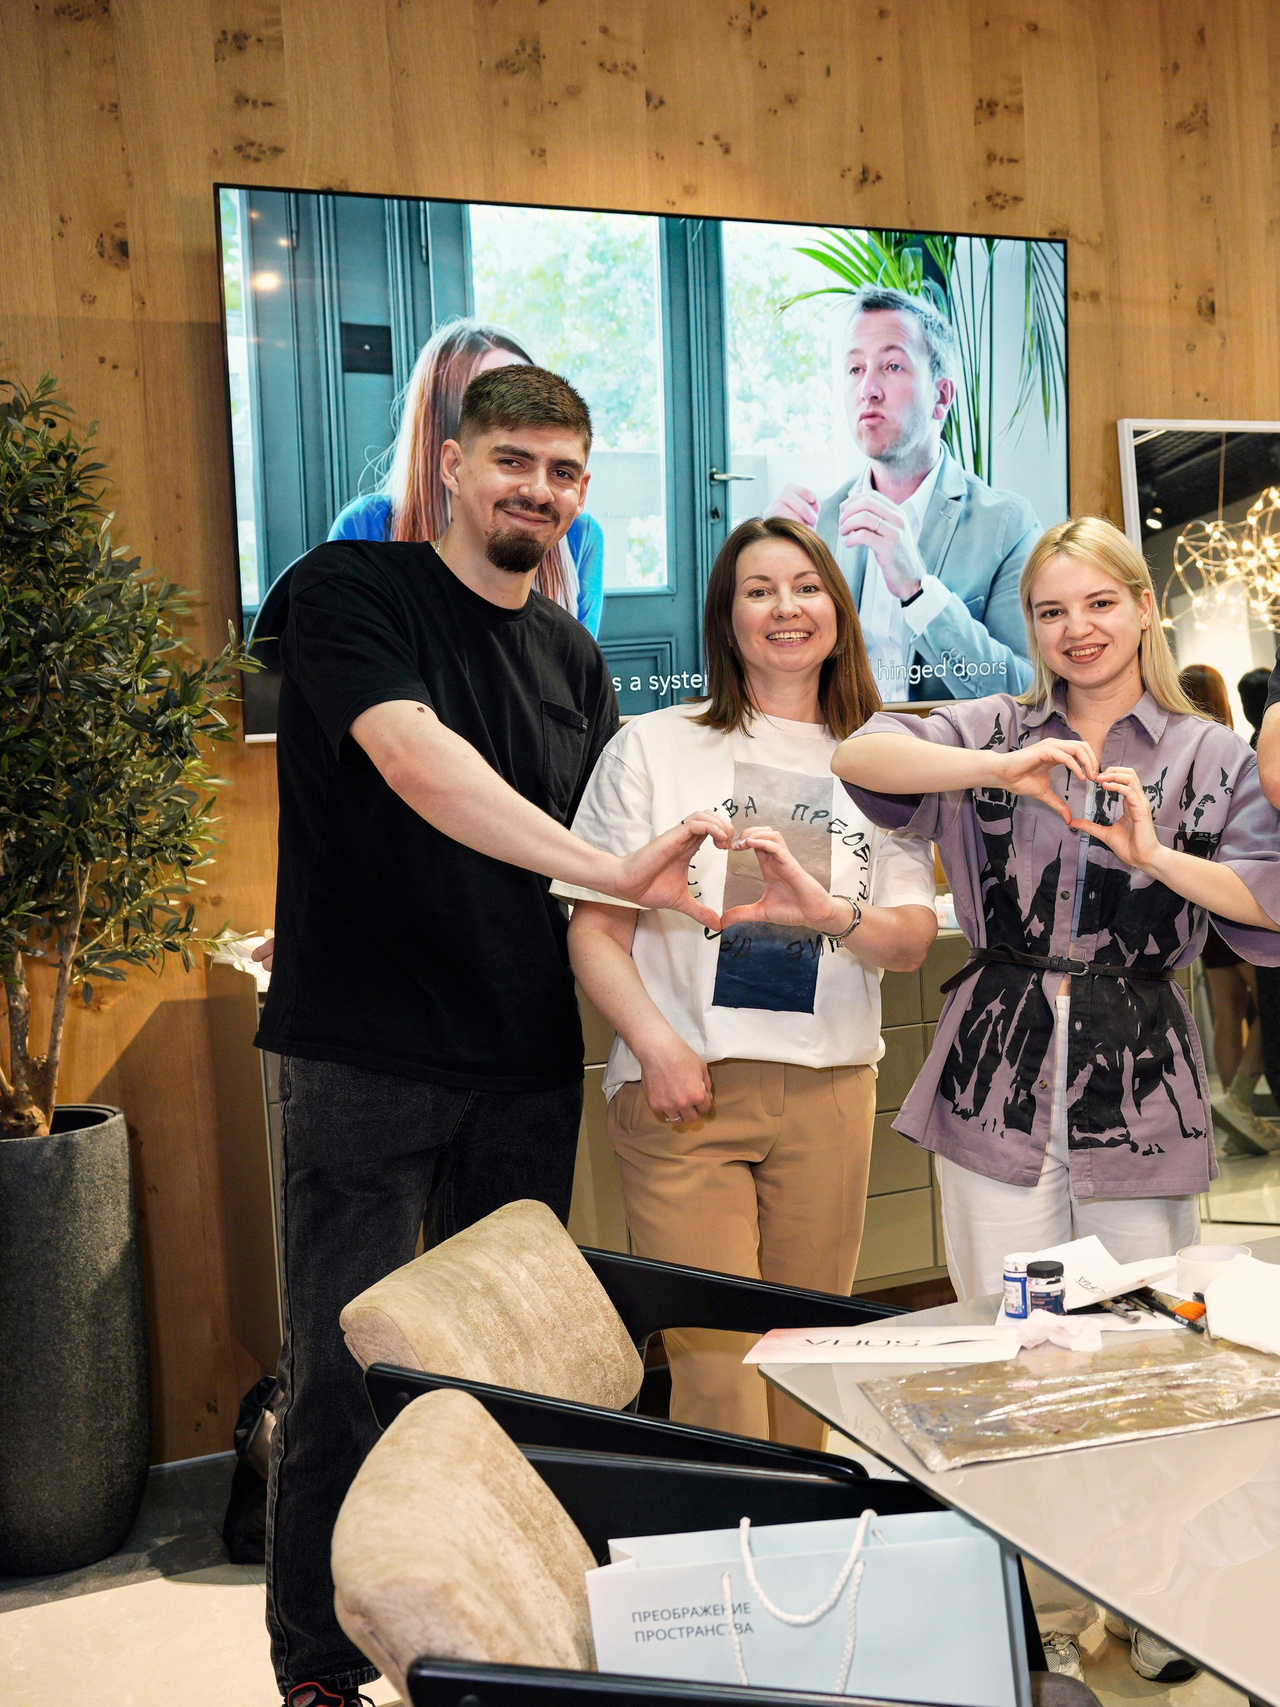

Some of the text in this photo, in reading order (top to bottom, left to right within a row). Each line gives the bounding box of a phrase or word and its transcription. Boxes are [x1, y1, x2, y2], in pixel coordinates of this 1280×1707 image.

[876, 652, 1008, 685] hinged doors
[629, 673, 642, 692] a
[648, 669, 709, 697] syste
[634, 1622, 755, 1643] ПРОСТРАНСВА
